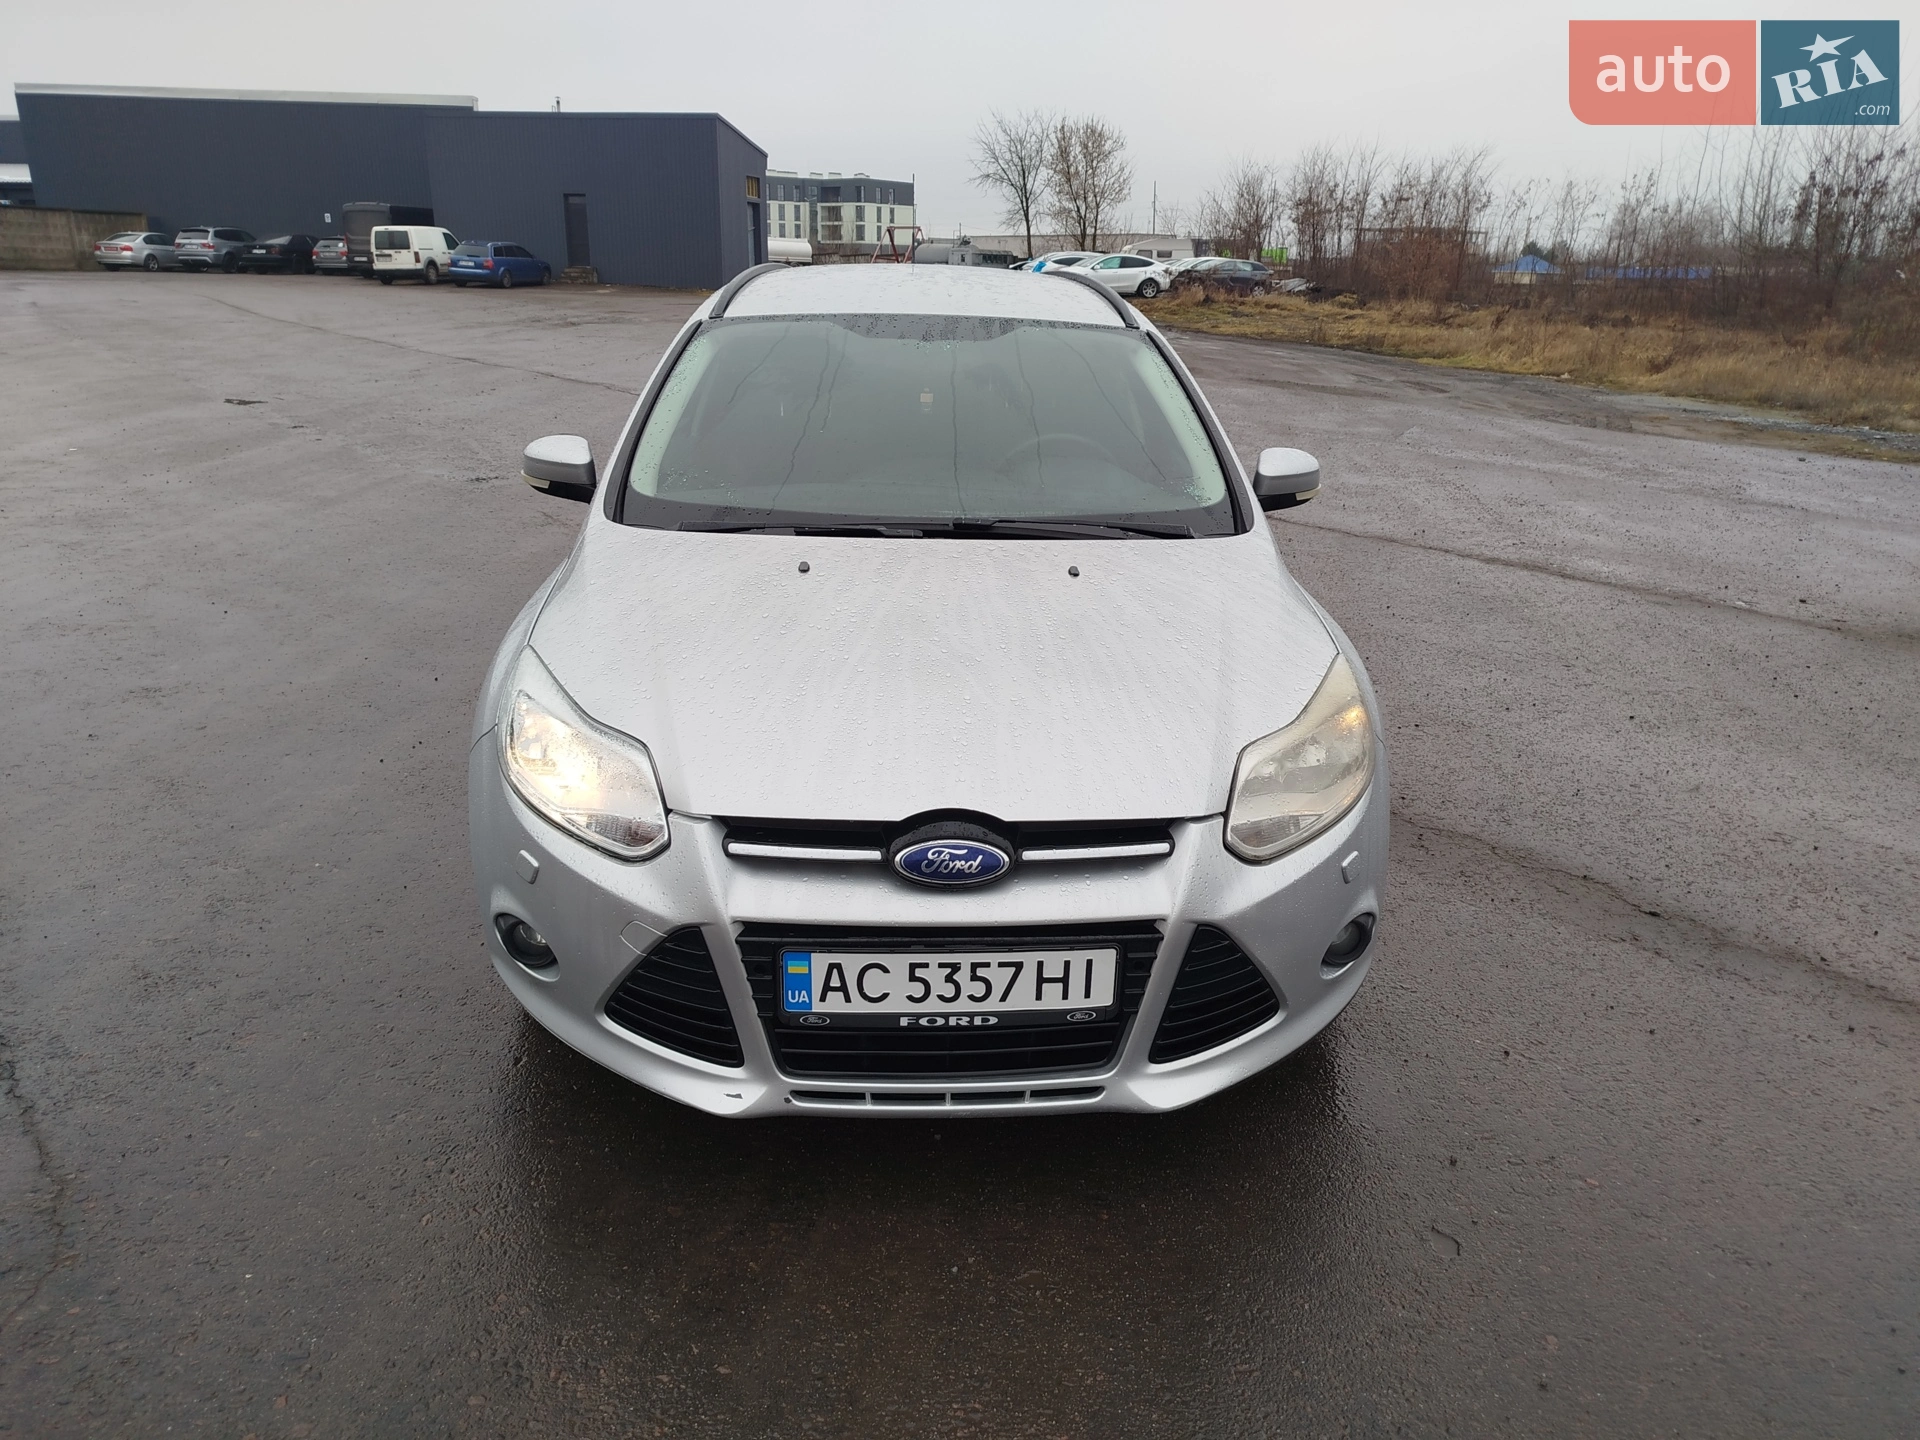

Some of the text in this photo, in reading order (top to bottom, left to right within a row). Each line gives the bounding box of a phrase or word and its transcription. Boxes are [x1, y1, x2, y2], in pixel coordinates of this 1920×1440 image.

[921, 847, 983, 874] Ford
[818, 958, 1094, 1004] AC 5357 HI
[788, 990, 809, 1004] UA
[900, 1015, 999, 1027] FORD
